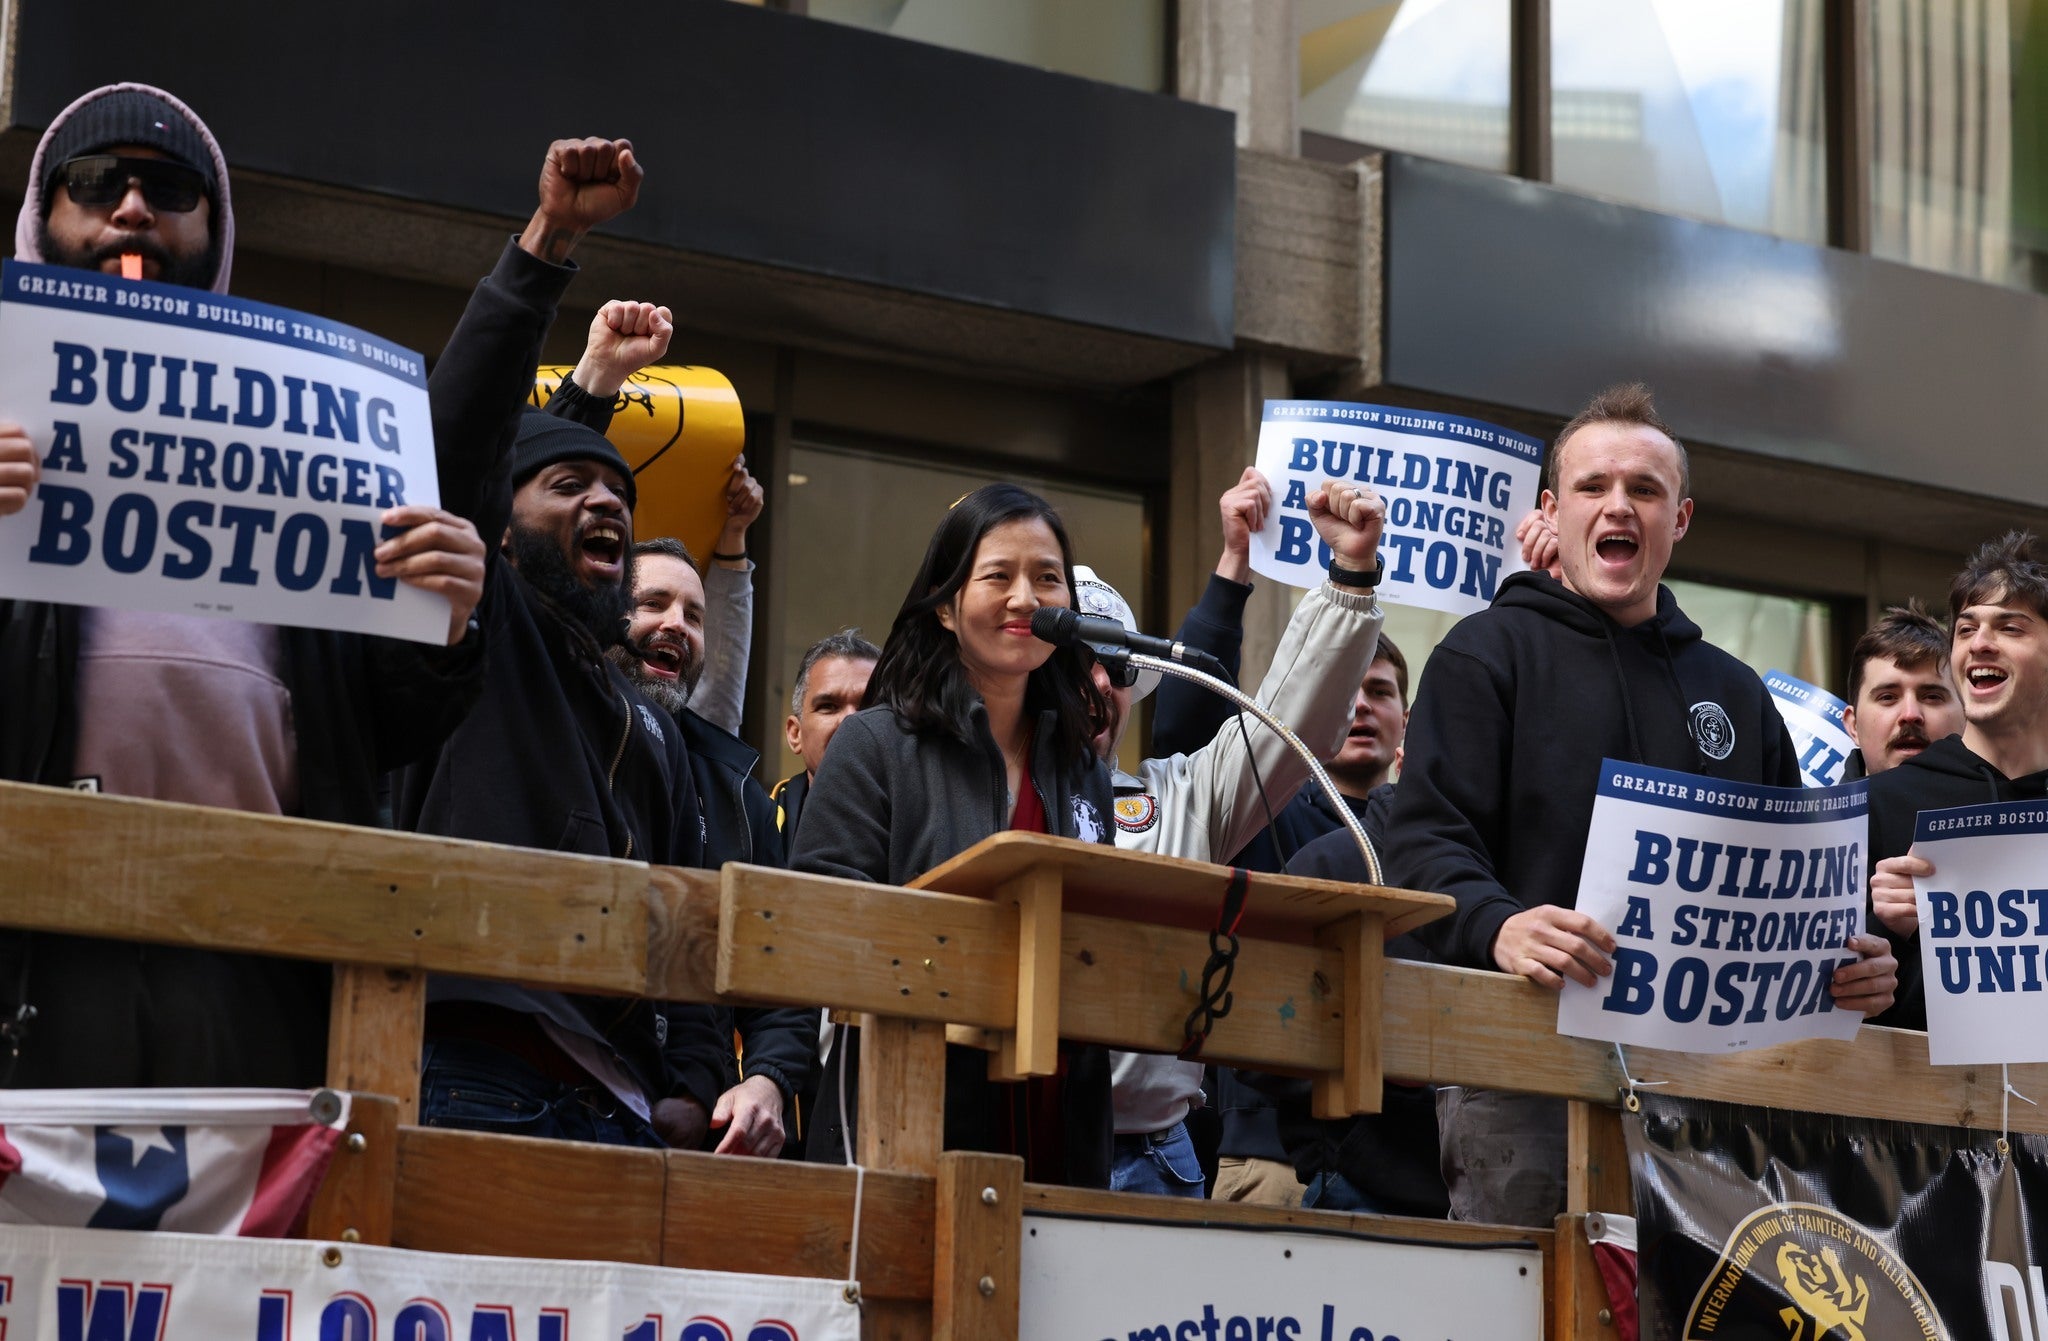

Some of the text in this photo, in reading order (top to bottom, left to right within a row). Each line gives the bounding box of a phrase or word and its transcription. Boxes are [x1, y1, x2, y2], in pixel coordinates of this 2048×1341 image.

[18, 275, 419, 378] GREATER BOSTON BUILDING TRADES UNIONS
[50, 340, 402, 455] BUILDING
[1273, 406, 1538, 457] GREATER BOSTON BUILDING TRADES UNIONS
[42, 420, 407, 509] A STRONGER
[1288, 437, 1512, 512] BUILDING
[1281, 479, 1505, 550] A ONGER
[1766, 677, 1845, 721] GREATER BOSTO
[1612, 773, 1688, 800] GREATER
[1695, 788, 1759, 811] BOSTON
[1764, 799, 1820, 813] BUILDING
[1822, 795, 1849, 811] TRADES
[1928, 810, 2048, 832] GREATER BOSTO
[1627, 829, 1859, 900] BUILDING
[1616, 895, 1857, 952] A STRONGER
[1935, 944, 2048, 995] UNI
[1698, 1236, 1759, 1332] INTERNATIONAL
[1751, 1217, 1783, 1245] UNION
[1781, 1214, 1795, 1232] OF
[1798, 1213, 1852, 1245] PAINTERS
[1853, 1234, 1877, 1260] AND
[1877, 1255, 1915, 1299] ALLIED
